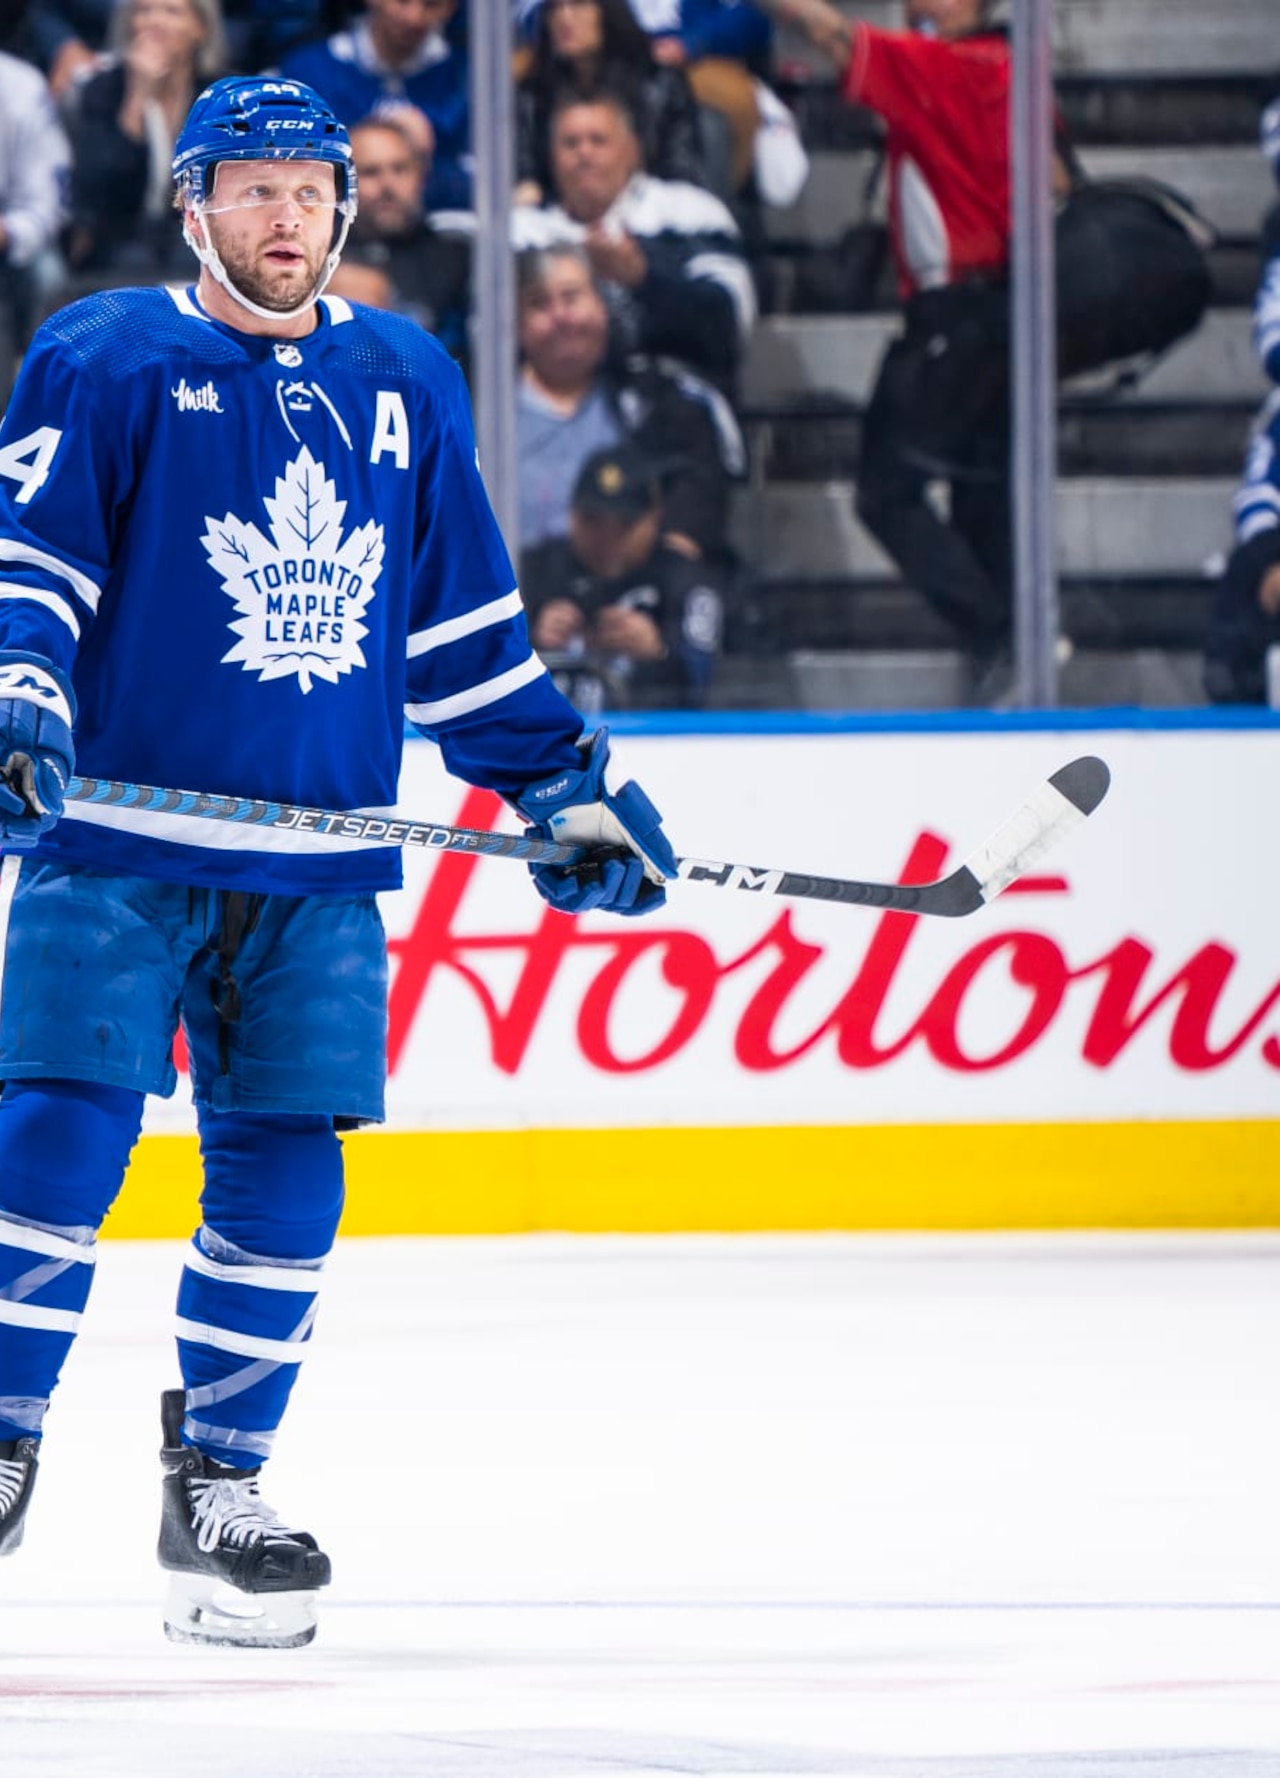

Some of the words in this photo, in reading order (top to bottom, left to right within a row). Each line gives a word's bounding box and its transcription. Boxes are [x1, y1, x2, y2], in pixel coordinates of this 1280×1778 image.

[265, 119, 315, 131] CCM
[171, 377, 225, 414] Milk
[369, 390, 411, 470] A
[242, 558, 363, 600] TORONTO
[266, 593, 346, 618] MAPLE
[265, 620, 345, 644] LEAFS
[275, 808, 452, 849] JETSPEED
